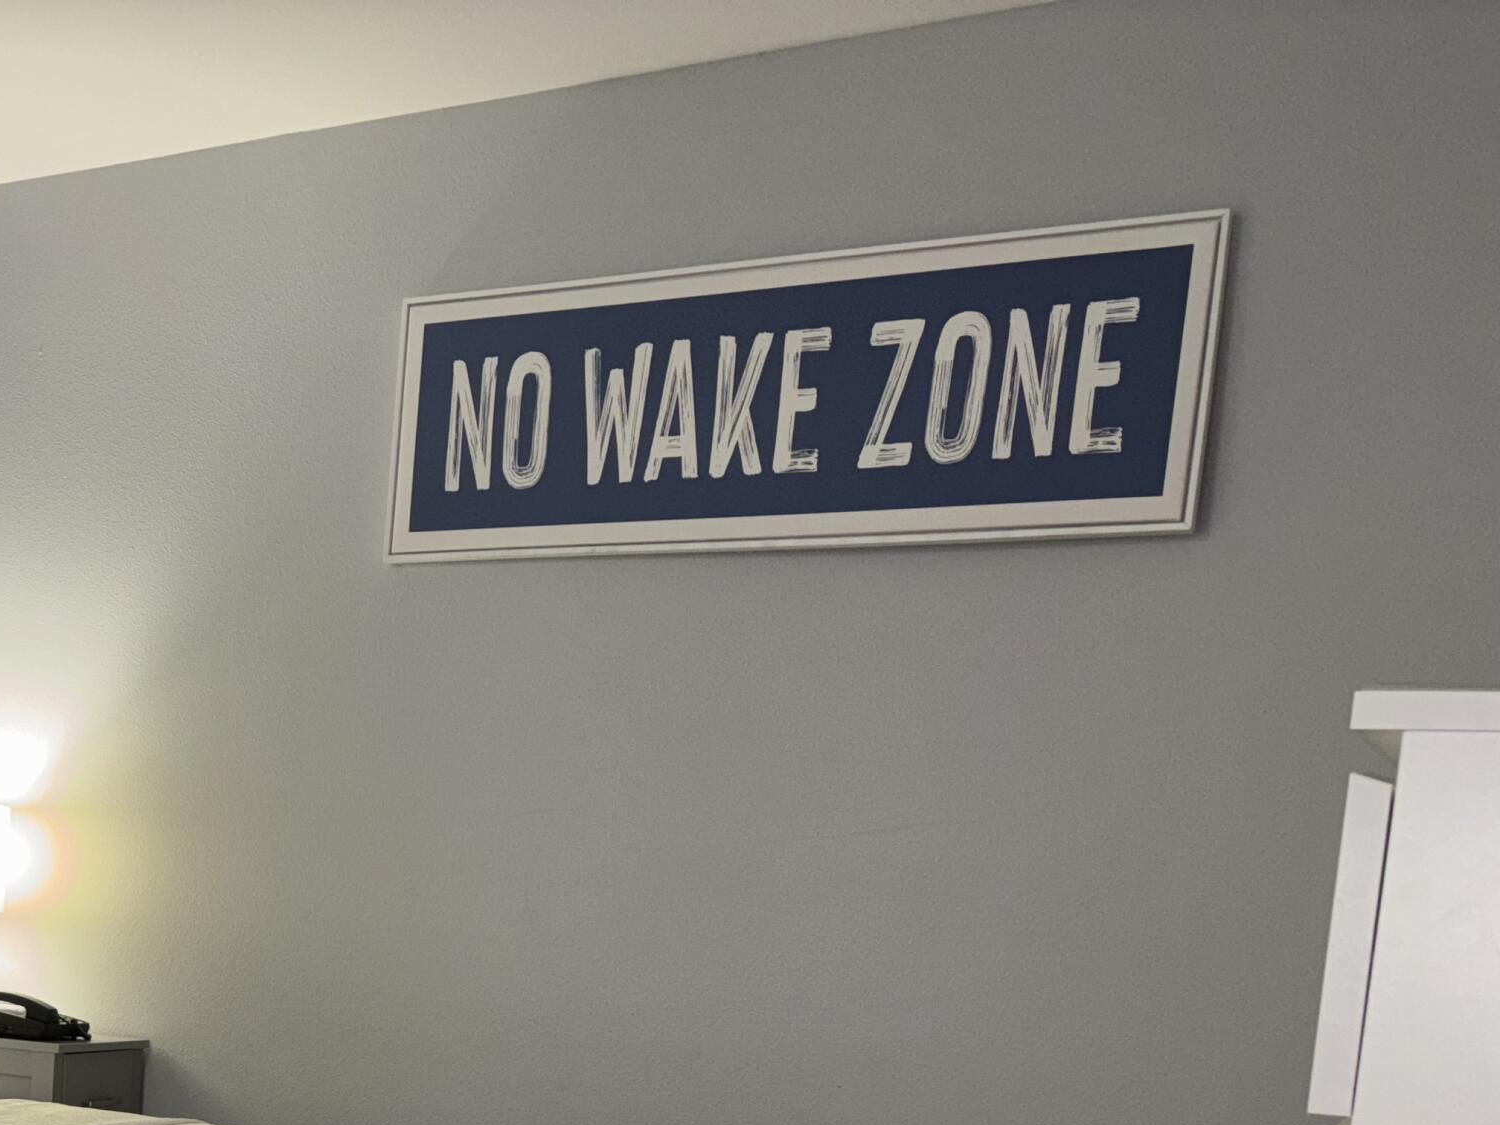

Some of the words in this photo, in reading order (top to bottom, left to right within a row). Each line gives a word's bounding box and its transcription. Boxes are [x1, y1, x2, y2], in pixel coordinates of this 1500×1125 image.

[444, 351, 551, 492] NO
[585, 326, 832, 485] WAKE
[858, 297, 1140, 469] ZONE
